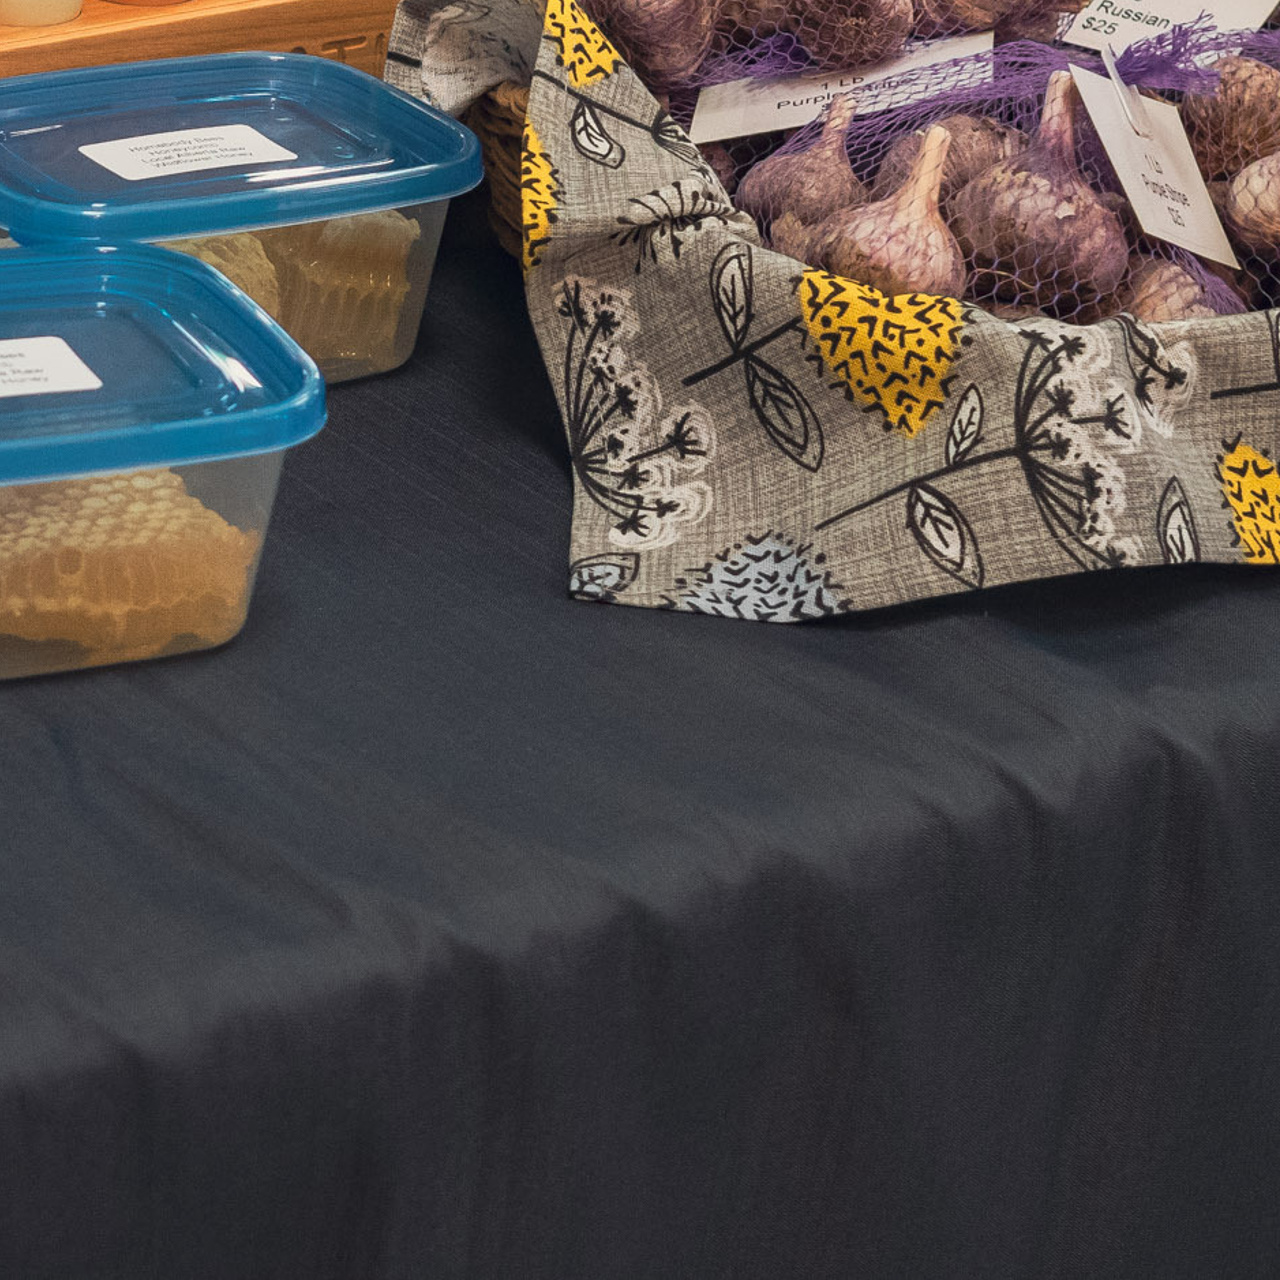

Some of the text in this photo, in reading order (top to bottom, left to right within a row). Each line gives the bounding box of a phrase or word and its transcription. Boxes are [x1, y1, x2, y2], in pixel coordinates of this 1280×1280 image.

[1096, 0, 1171, 30] Russian
[1081, 16, 1119, 35] $25
[821, 76, 865, 91] 1 Lb
